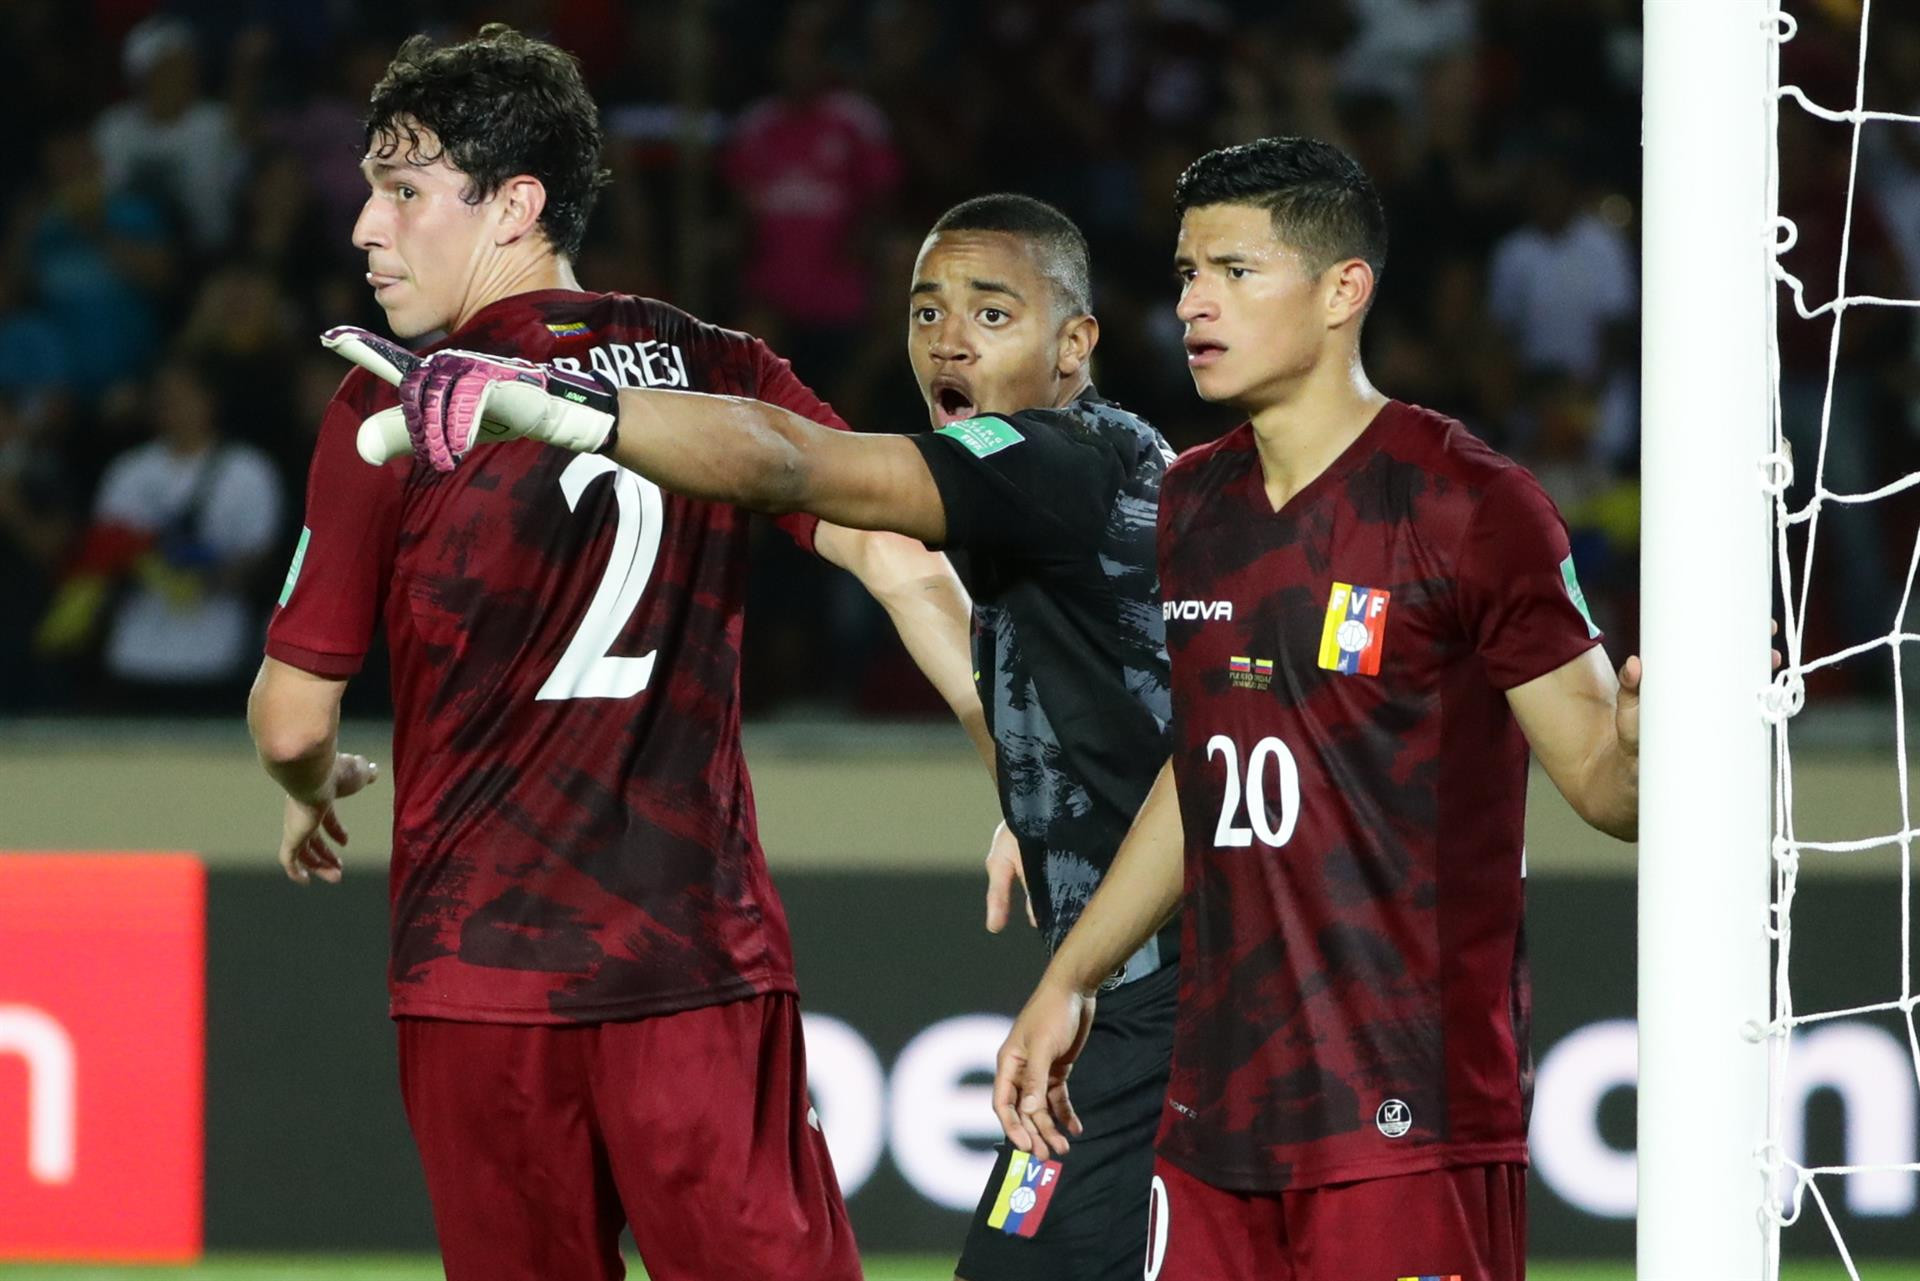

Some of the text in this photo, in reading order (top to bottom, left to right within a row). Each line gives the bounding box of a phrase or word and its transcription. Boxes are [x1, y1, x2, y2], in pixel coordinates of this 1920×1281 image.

[534, 452, 664, 700] 2
[1331, 589, 1386, 618] FVF
[1206, 734, 1301, 848] 20
